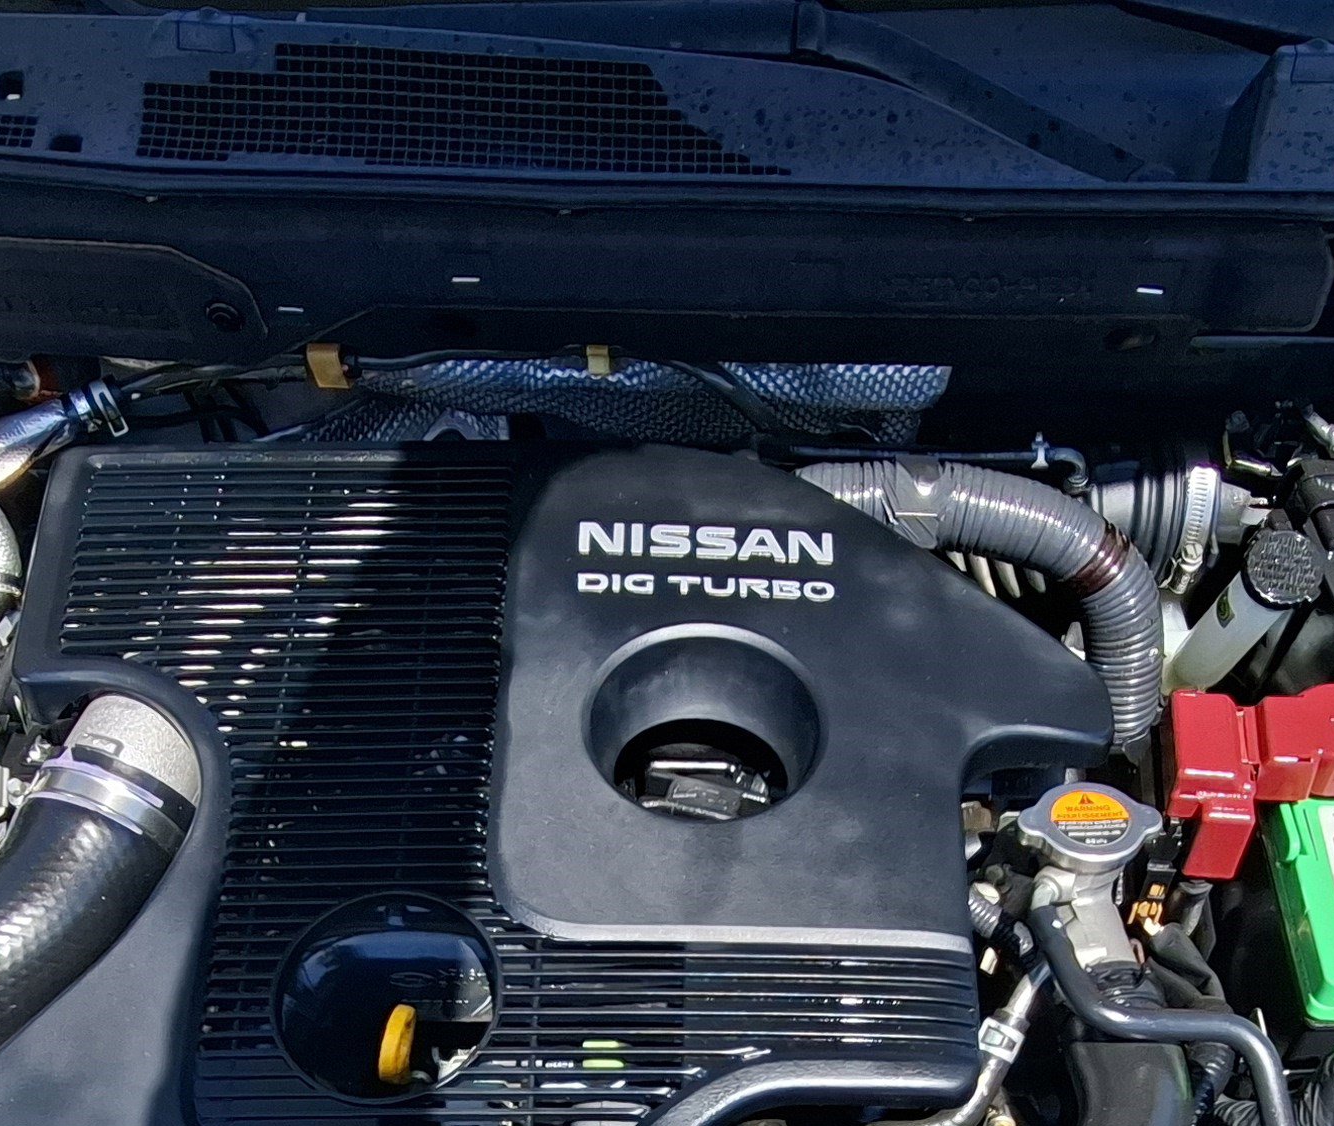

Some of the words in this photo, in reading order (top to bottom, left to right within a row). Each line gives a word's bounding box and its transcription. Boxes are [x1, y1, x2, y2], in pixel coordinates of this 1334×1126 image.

[578, 521, 835, 565] NISSAN
[577, 572, 654, 595] DIG
[668, 575, 835, 602] TURBO
